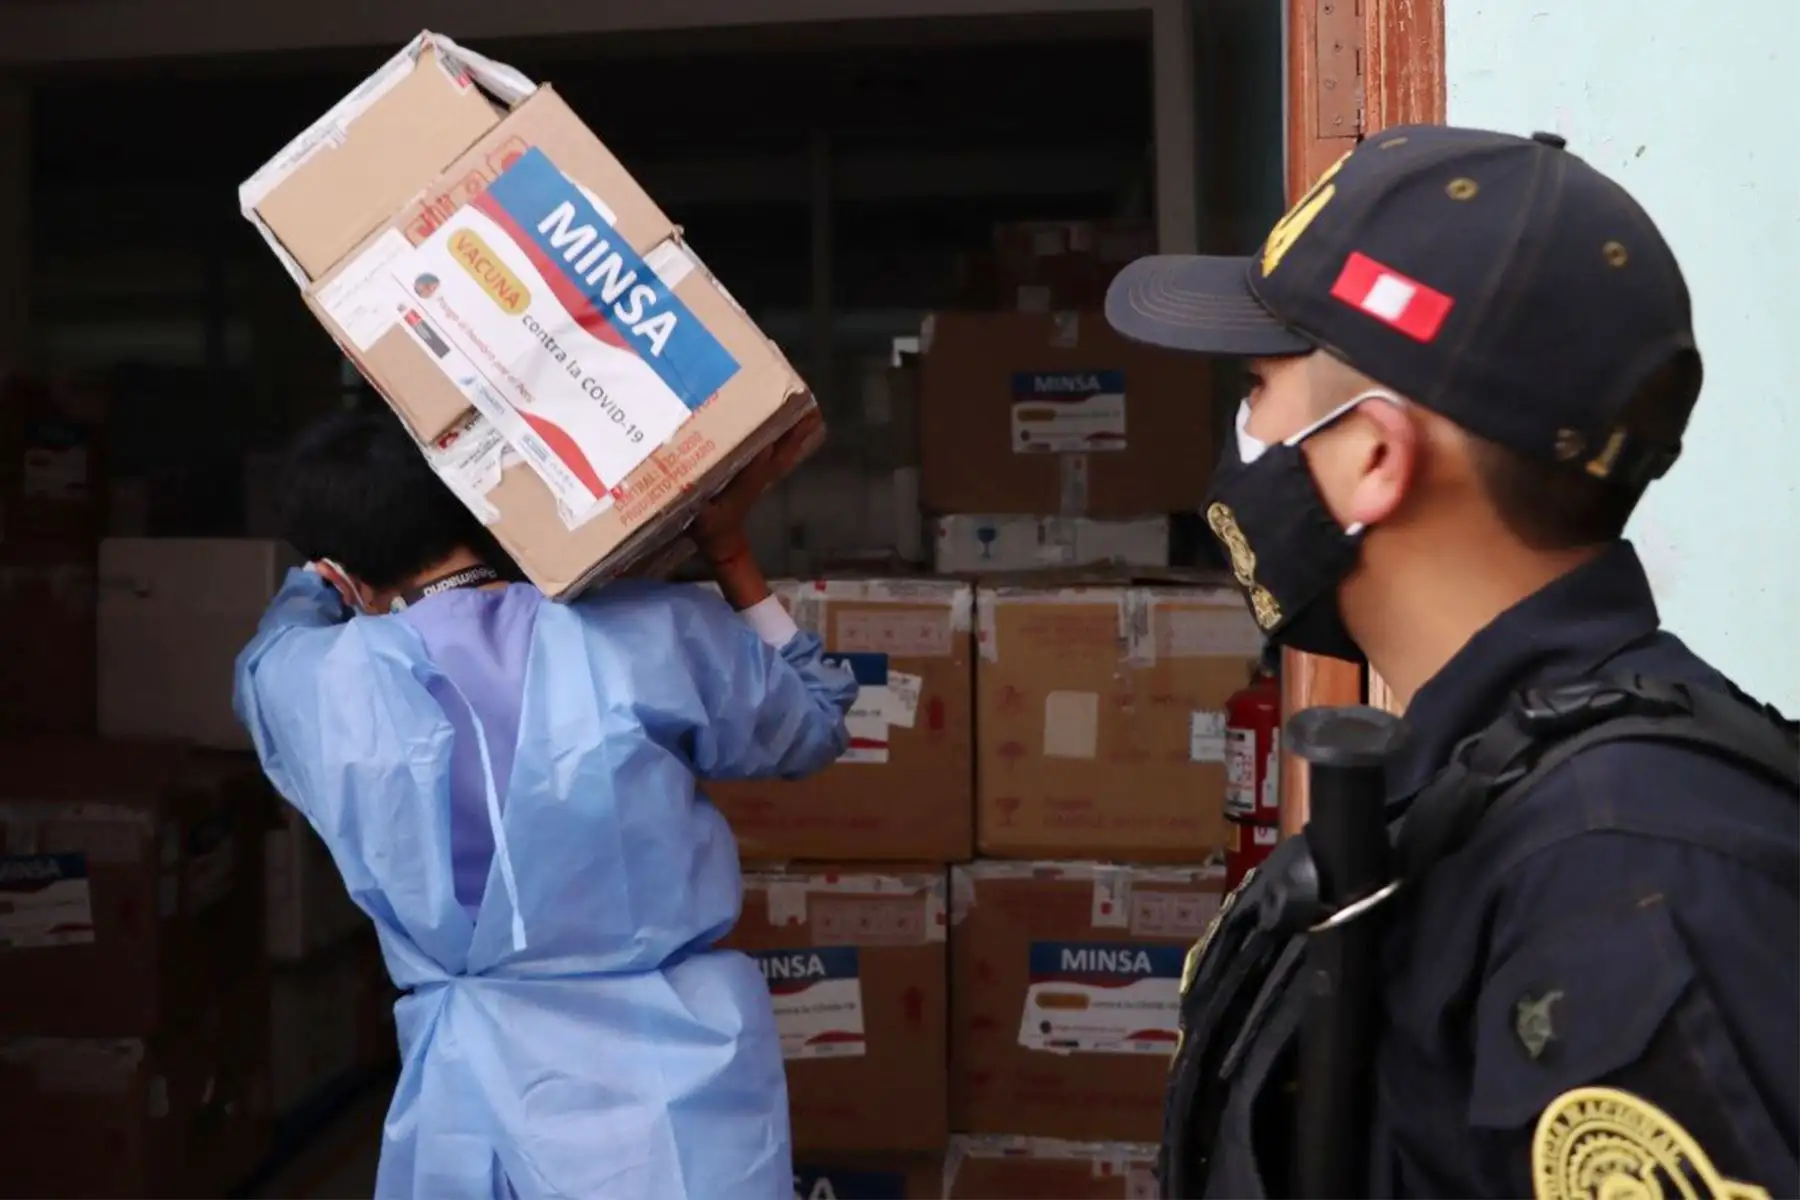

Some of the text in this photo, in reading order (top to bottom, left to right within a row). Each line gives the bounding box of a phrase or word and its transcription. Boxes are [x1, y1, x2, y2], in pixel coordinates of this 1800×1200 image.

[537, 200, 678, 357] MINSA
[456, 234, 645, 443] VACUNA contra la COVID-19
[1034, 374, 1102, 393] MINSA
[762, 953, 827, 979] INSA
[1060, 947, 1153, 974] MINSA
